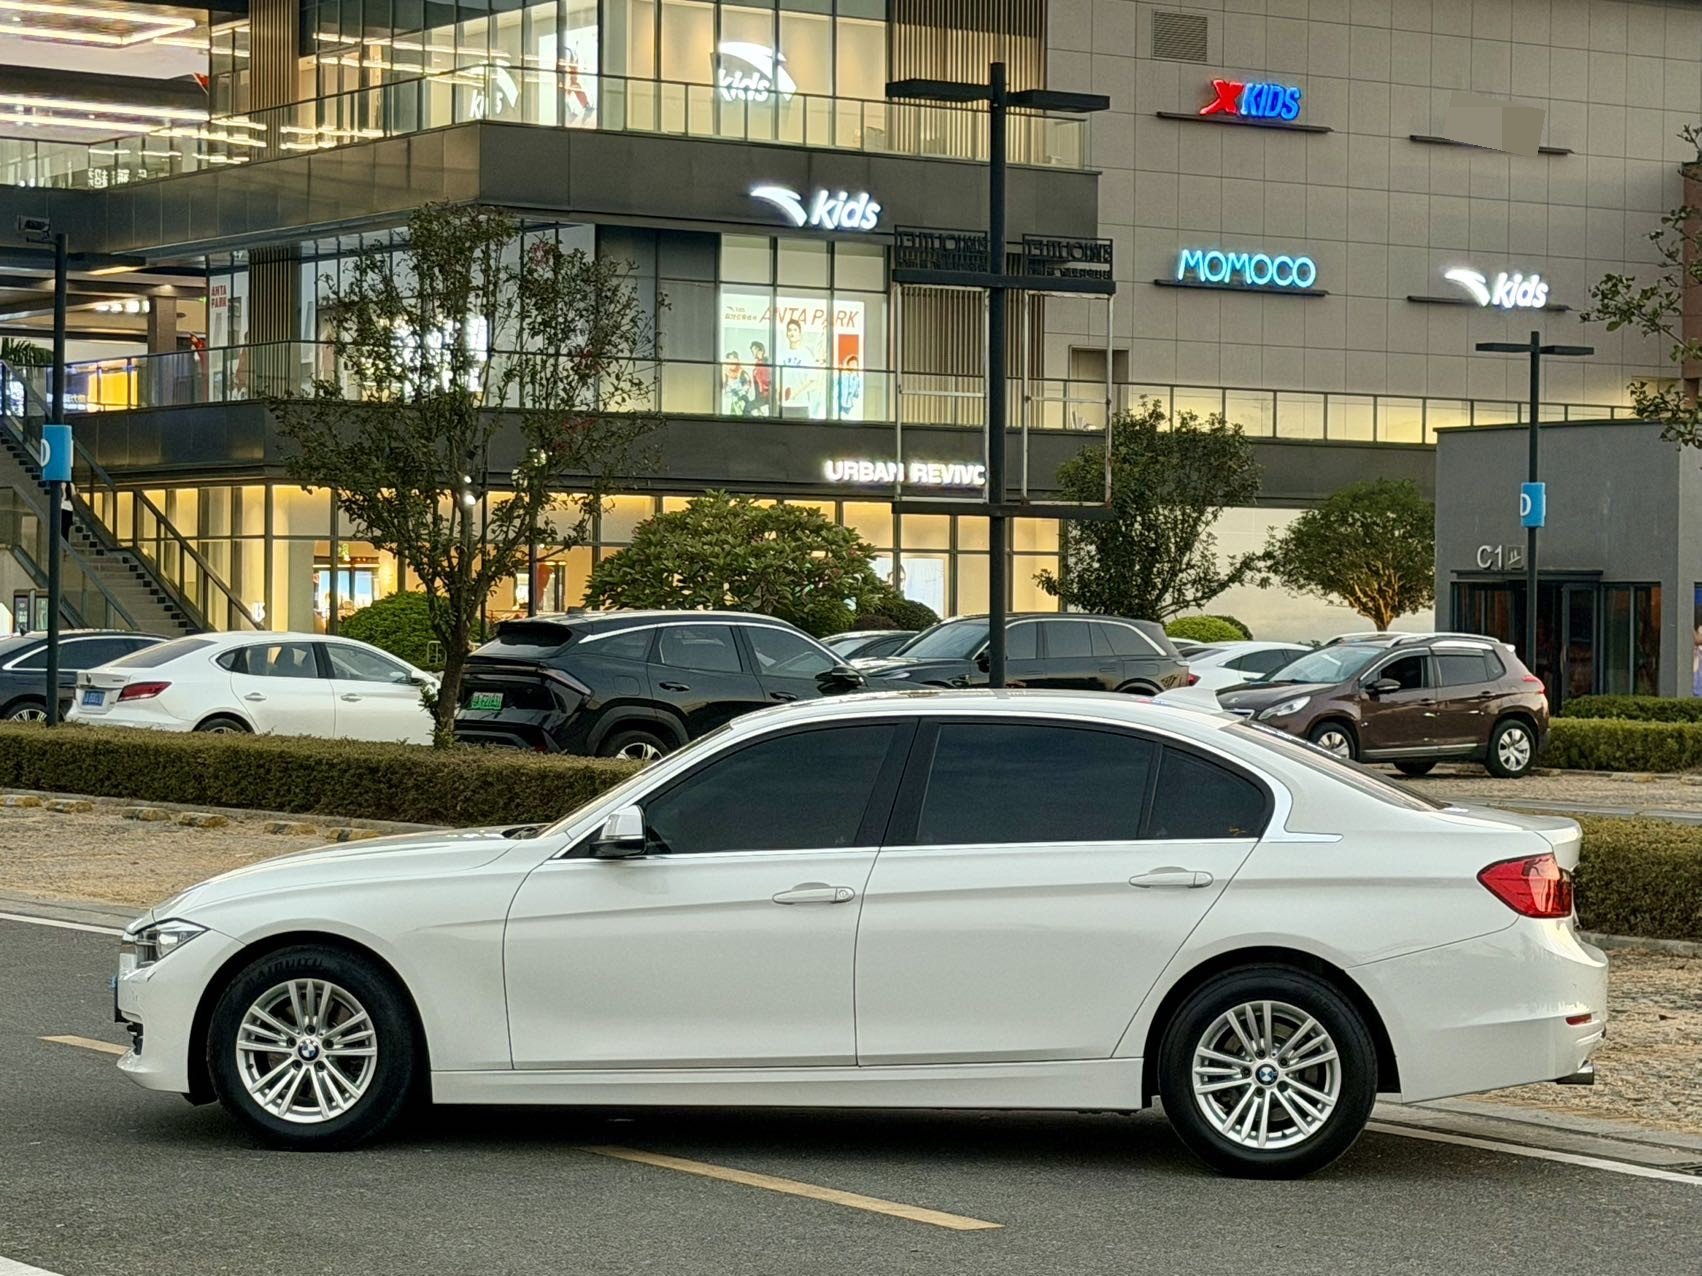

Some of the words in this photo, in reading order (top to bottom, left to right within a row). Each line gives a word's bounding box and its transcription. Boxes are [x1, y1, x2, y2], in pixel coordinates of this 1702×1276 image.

[718, 68, 770, 101] kids
[811, 189, 881, 229] kids
[1177, 249, 1316, 288] MOMOCO
[1492, 272, 1549, 308] kids
[811, 309, 859, 328] PRK
[825, 460, 905, 482] URBAN
[1477, 545, 1502, 568] C1
